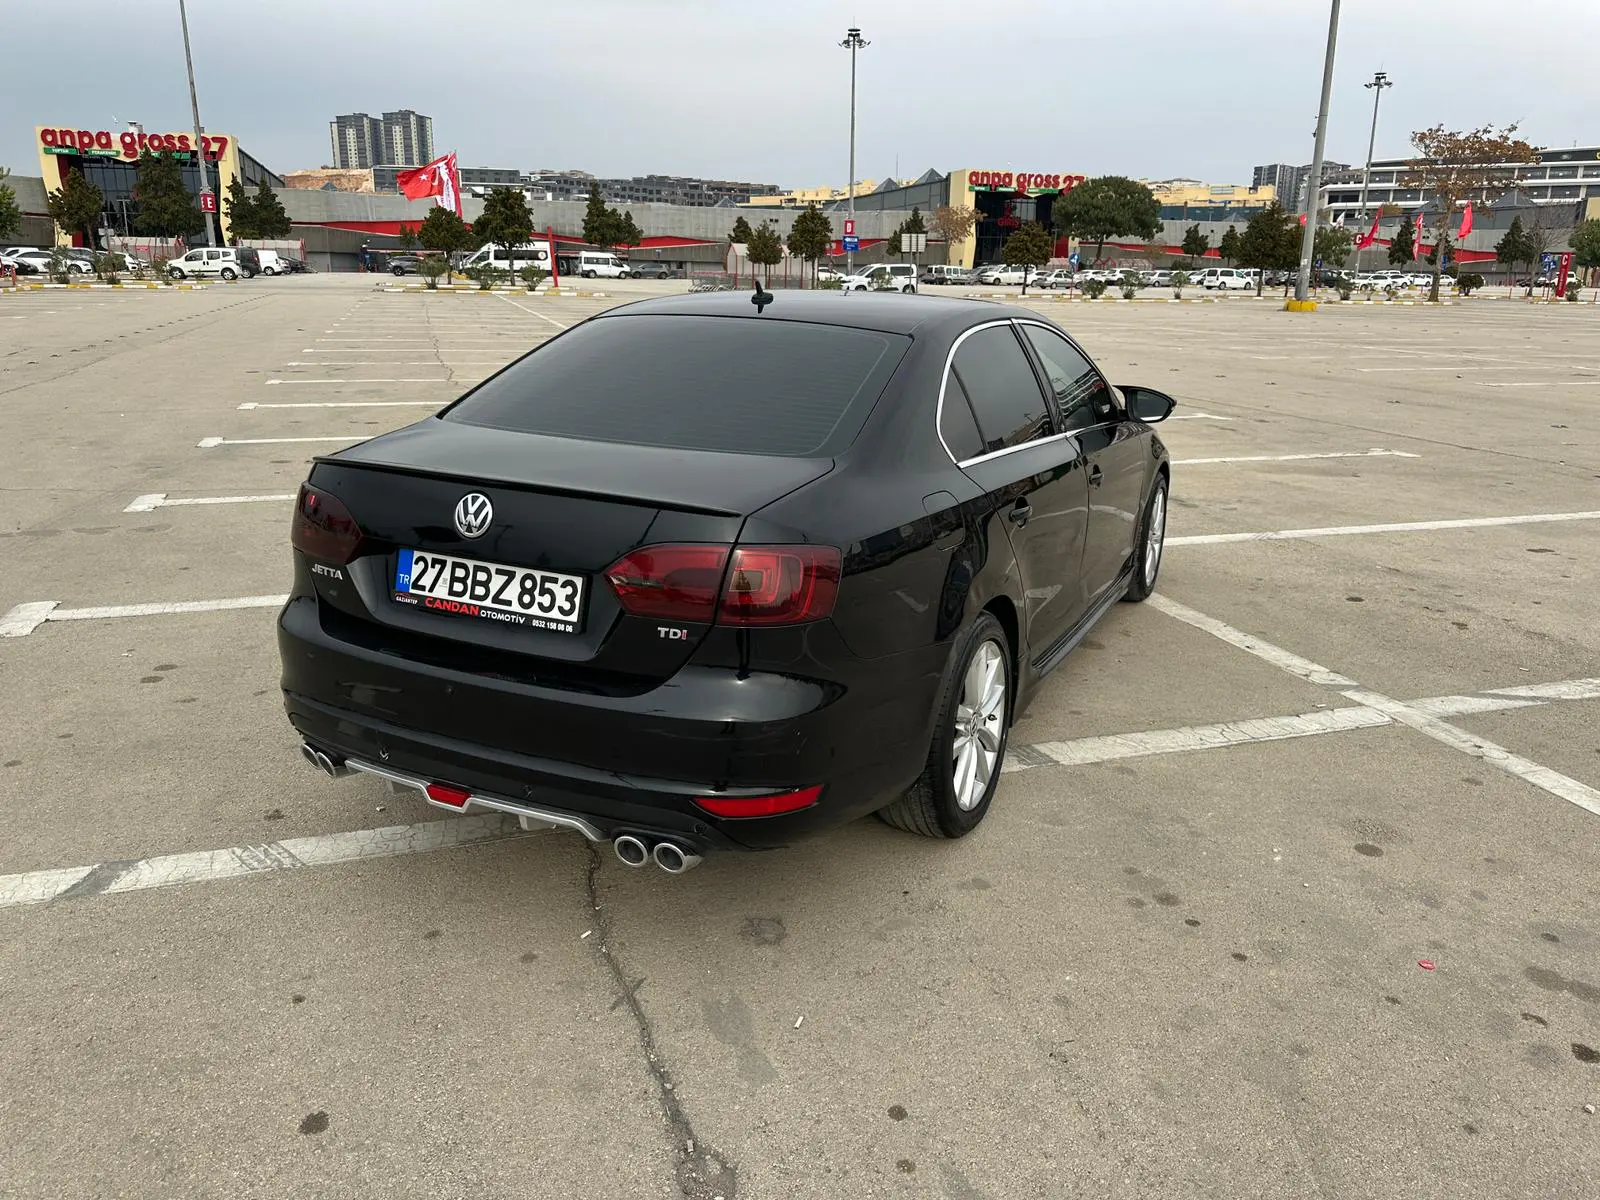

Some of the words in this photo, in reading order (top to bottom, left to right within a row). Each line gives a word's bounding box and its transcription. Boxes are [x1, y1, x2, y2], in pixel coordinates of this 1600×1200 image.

[40, 128, 112, 155] anpa
[120, 132, 190, 158] gross
[968, 171, 1013, 191] anpa
[1017, 173, 1061, 194] gross
[207, 197, 213, 208] E
[1356, 234, 1362, 243] C
[1562, 255, 1568, 265] C
[312, 563, 343, 580] JETTA
[399, 573, 410, 585] TR
[424, 596, 480, 616] CANDAN
[480, 610, 526, 625] OTOMOTİV
[532, 619, 546, 628] 0532
[657, 626, 688, 641] TDI
